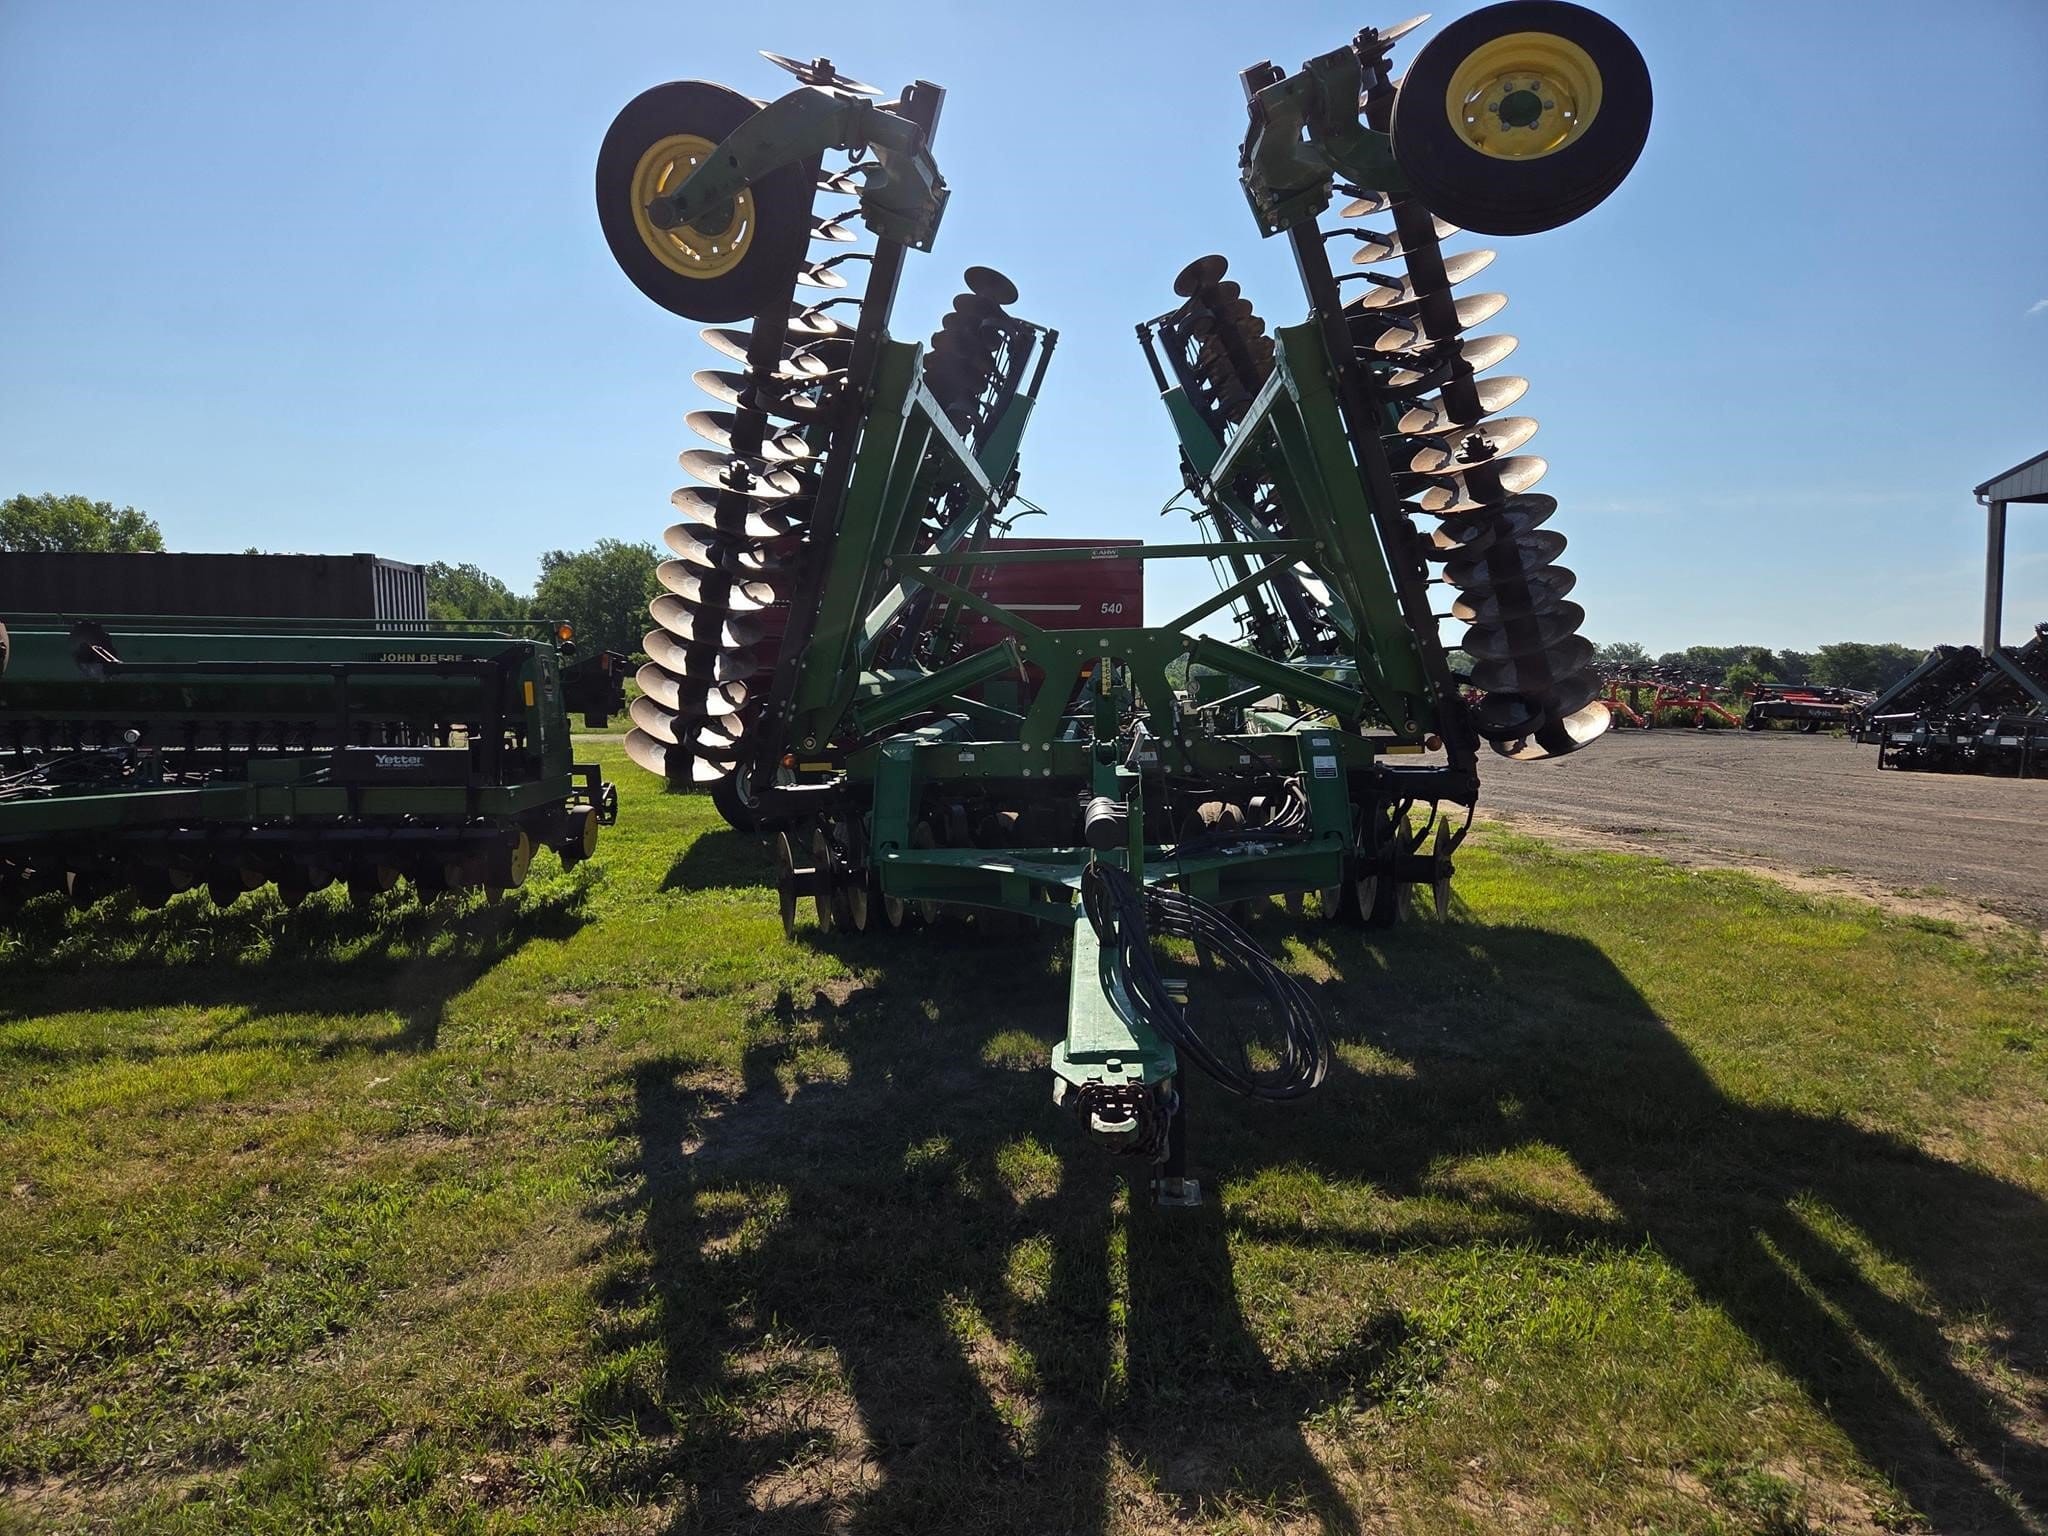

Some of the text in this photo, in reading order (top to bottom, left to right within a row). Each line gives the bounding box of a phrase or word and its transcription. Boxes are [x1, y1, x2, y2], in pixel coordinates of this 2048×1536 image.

[1100, 602, 1123, 614] 540
[379, 653, 416, 662] JOHN
[375, 754, 421, 764] Yetter
